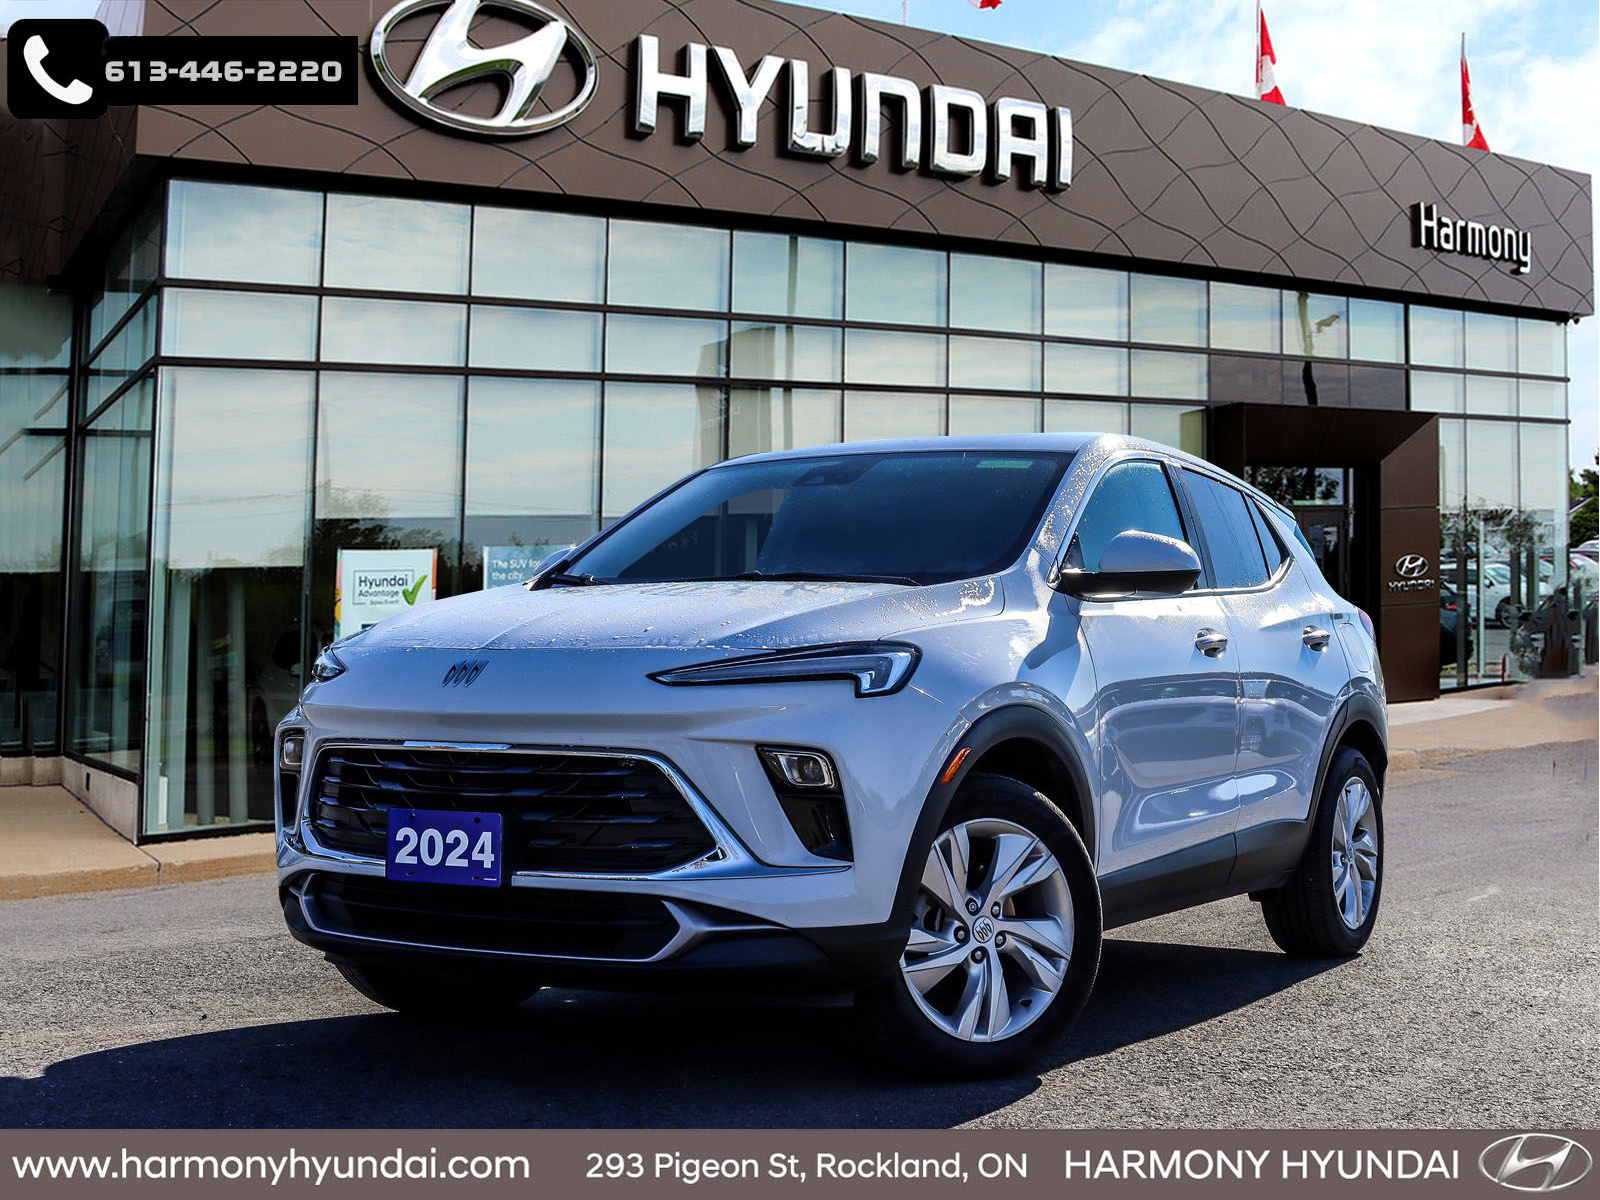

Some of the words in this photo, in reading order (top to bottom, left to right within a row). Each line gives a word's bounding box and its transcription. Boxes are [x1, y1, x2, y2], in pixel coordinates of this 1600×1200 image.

[635, 34, 1072, 190] HYUNDAI
[1419, 201, 1532, 273] Harmony
[492, 560, 508, 568] The
[510, 559, 528, 568] SUV
[358, 574, 408, 589] Hyundai
[492, 571, 505, 580] the
[358, 589, 399, 598] Advantage
[395, 827, 495, 868] 2024
